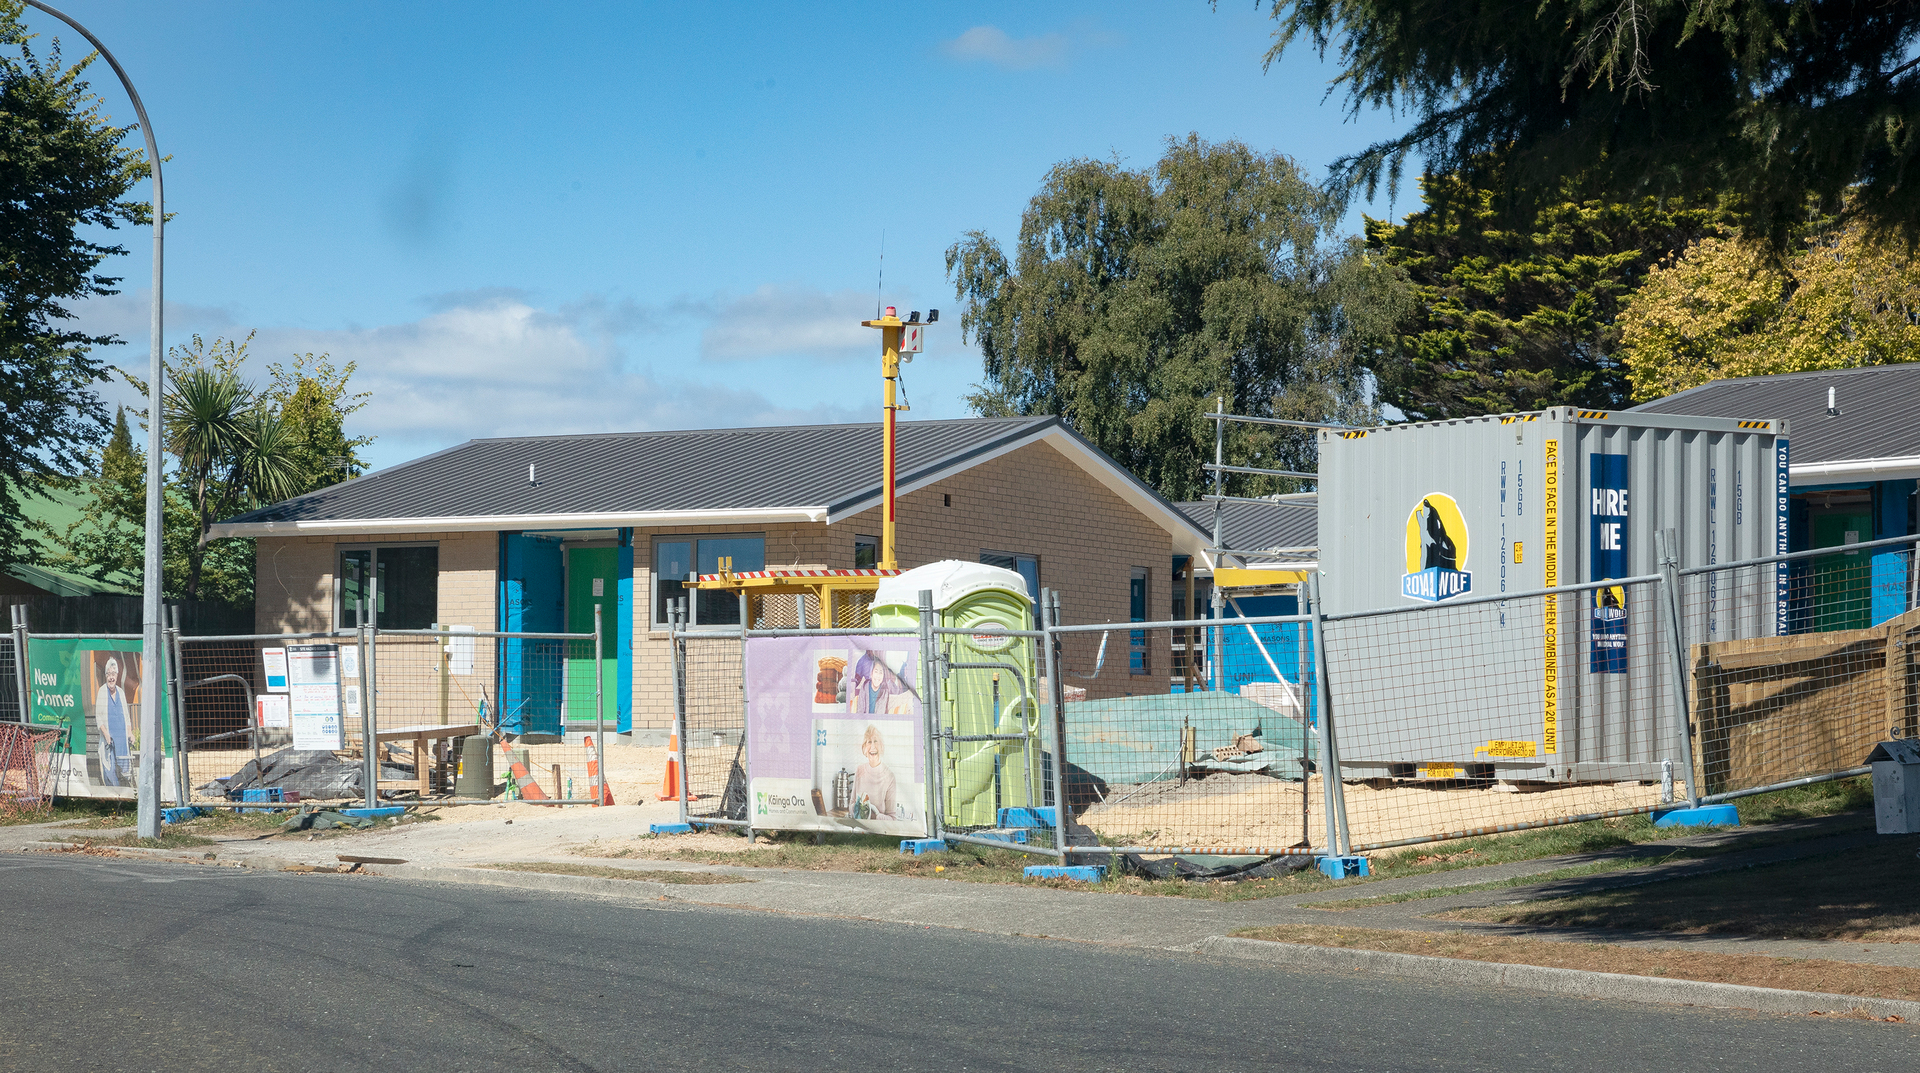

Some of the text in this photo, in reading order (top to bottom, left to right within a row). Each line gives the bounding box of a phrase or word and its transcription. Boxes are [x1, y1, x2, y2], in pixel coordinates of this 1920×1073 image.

[1546, 441, 1556, 468] FACE
[1546, 470, 1556, 484] TO
[1546, 488, 1556, 514] FACE
[1592, 488, 1628, 516] HIRE
[1779, 498, 1786, 511] DO
[1546, 517, 1556, 526] IN
[1546, 530, 1556, 550] THE
[1406, 571, 1468, 597] ROYAL WOLF
[1779, 574, 1786, 584] IN
[1546, 593, 1556, 625] WHEN
[1546, 628, 1556, 682] COMBINED
[34, 668, 57, 687] New
[36, 689, 74, 708] Homes
[1546, 685, 1556, 698] AS
[1545, 728, 1555, 751] UNIT
[791, 795, 805, 806] Ora
